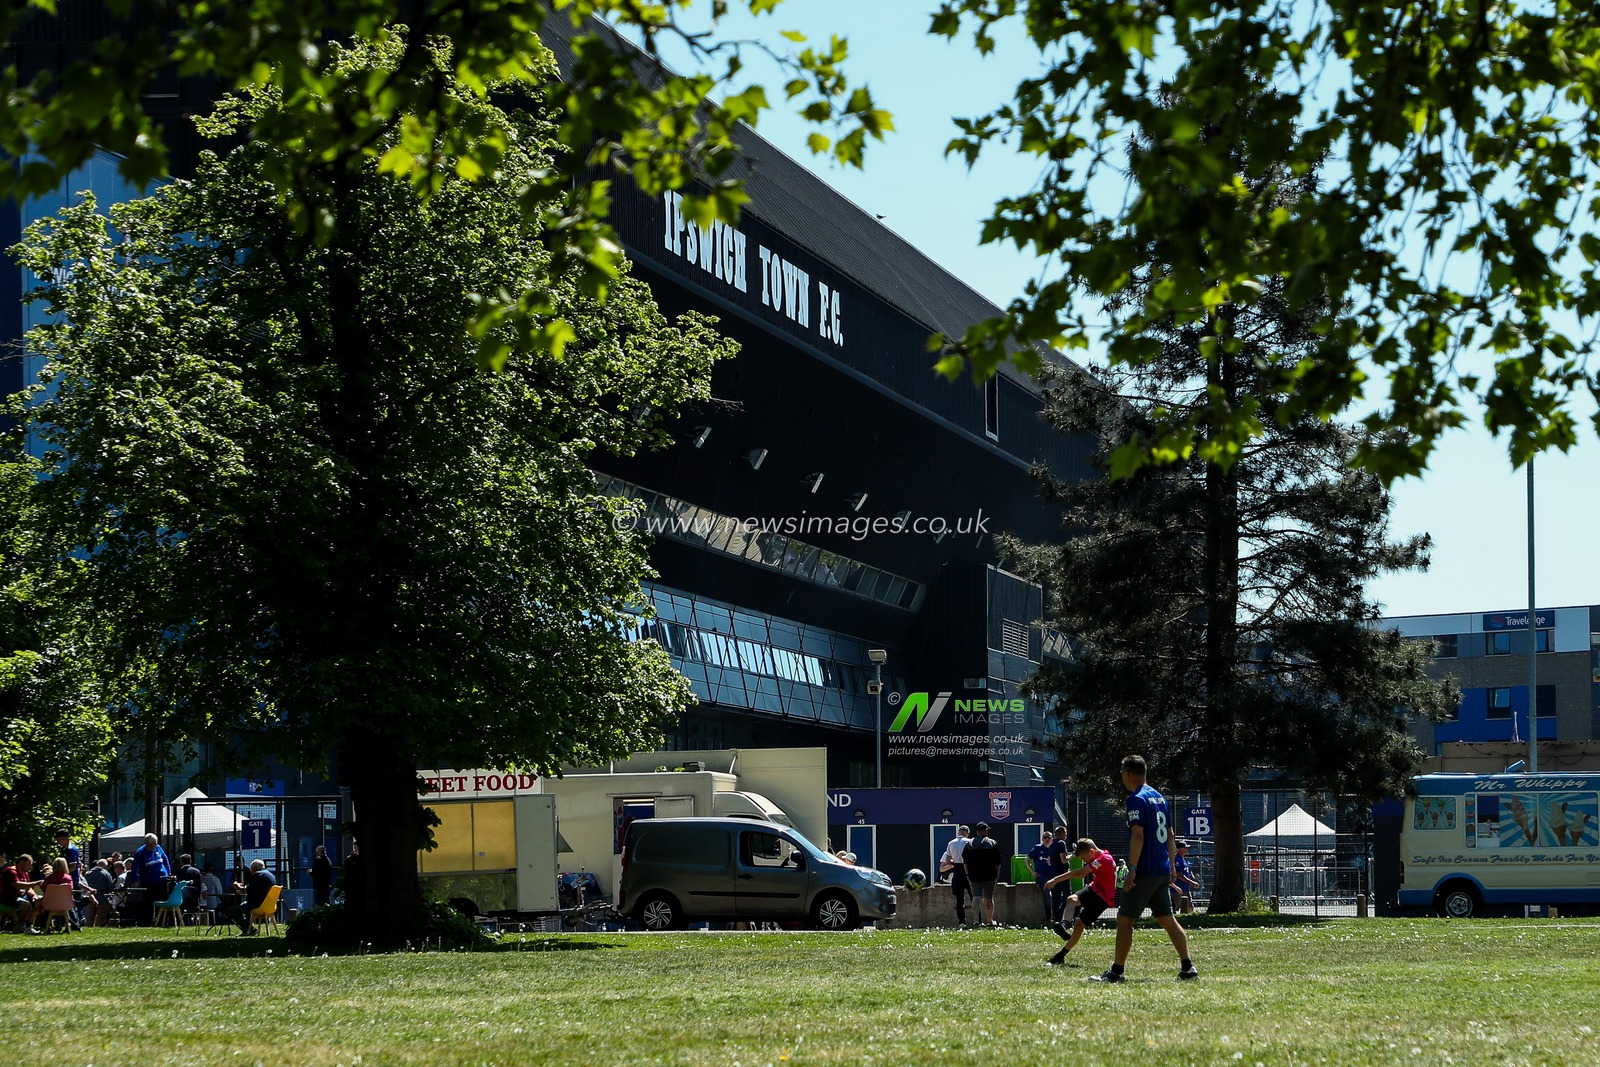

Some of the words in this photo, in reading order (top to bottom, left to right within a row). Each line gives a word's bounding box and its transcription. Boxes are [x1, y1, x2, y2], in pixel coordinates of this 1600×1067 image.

[664, 189, 747, 293] IPSWICH
[759, 244, 810, 328] TOWN
[818, 281, 844, 347] F.C.
[473, 774, 535, 791] FOOD
[1474, 780, 1506, 790] Mr
[1514, 778, 1587, 789] Whippy
[1156, 810, 1168, 844] 8
[1187, 816, 1211, 835] 1B
[252, 829, 260, 848] 1
[1566, 853, 1585, 862] For
